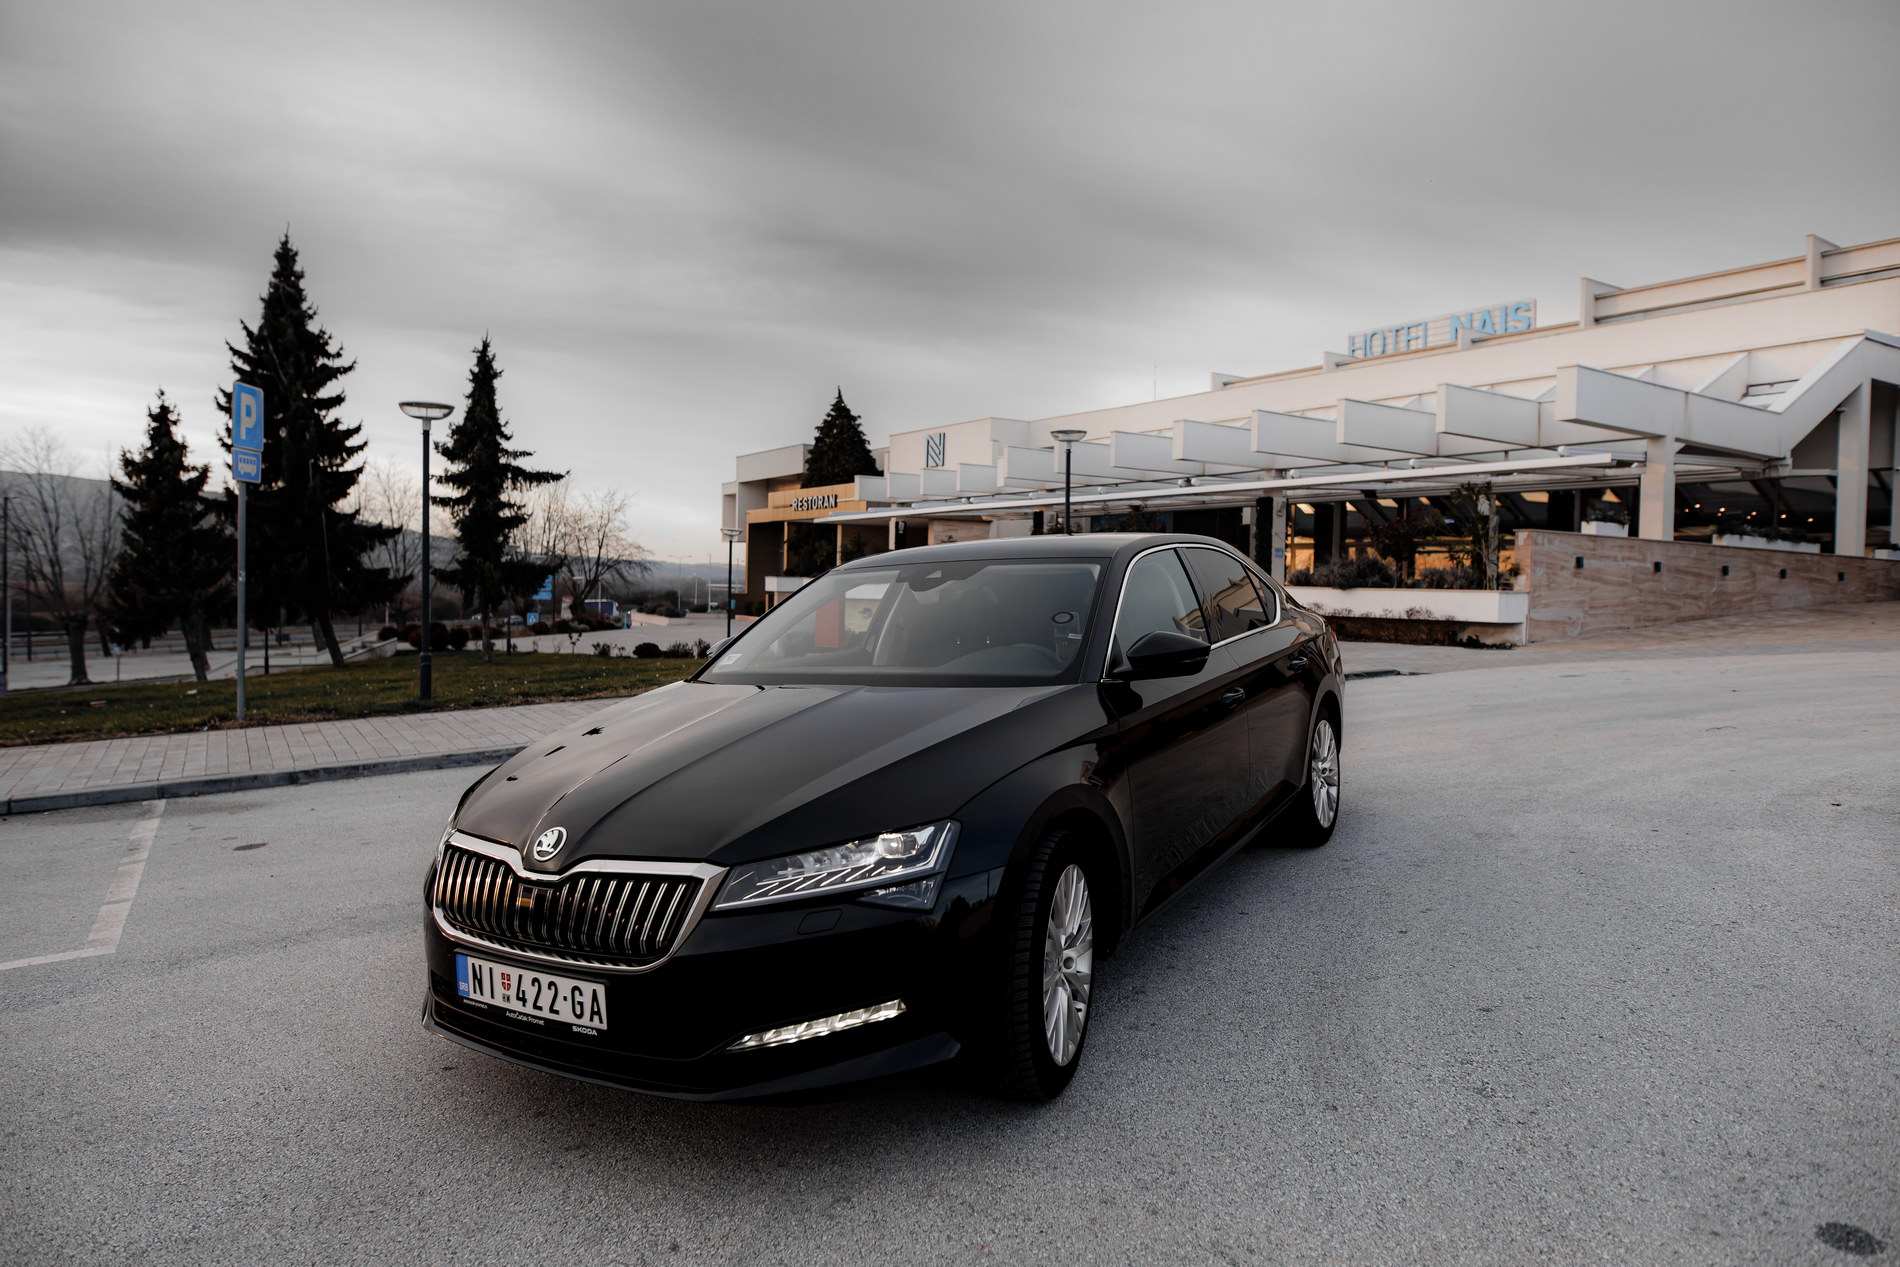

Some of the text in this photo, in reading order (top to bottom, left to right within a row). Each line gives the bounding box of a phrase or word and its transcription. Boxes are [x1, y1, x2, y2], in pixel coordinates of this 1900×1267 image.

[1348, 302, 1531, 359] HOTEL NAIS
[240, 392, 257, 440] P
[792, 494, 837, 511] RESTORAN
[471, 962, 495, 999] NI
